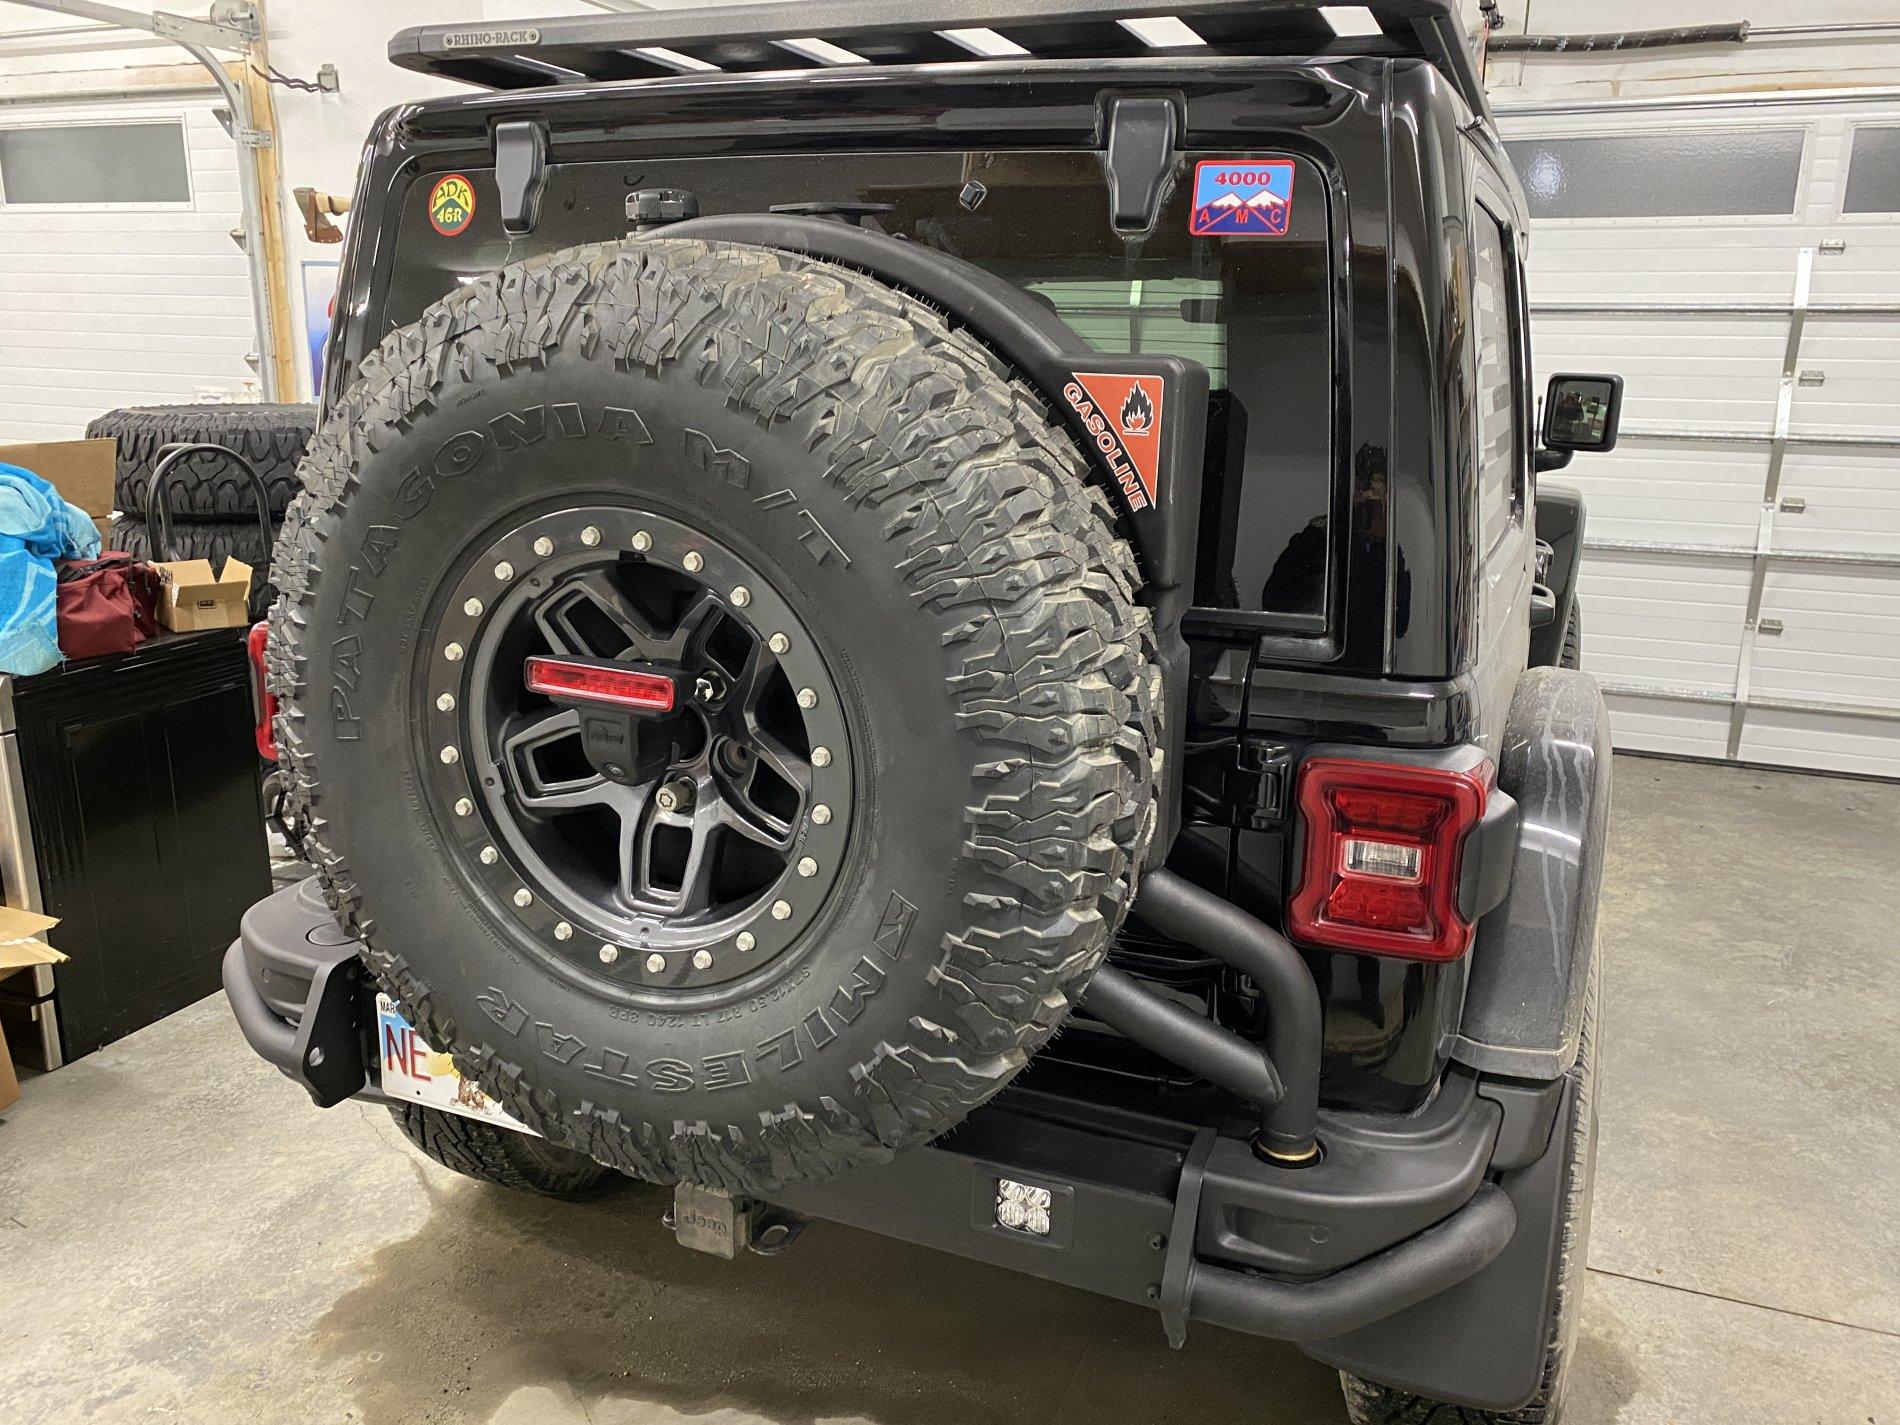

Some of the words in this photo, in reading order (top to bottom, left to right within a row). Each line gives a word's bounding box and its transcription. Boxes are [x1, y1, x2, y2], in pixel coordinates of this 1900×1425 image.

[453, 31, 528, 46] RHINO-RACK
[1213, 171, 1272, 187] 4000
[432, 180, 470, 210] ADK
[437, 207, 463, 223] 46R
[1063, 382, 1148, 513] GASOLINE
[331, 402, 654, 742] PATAGONIA
[476, 956, 886, 1092] MILESTAR
